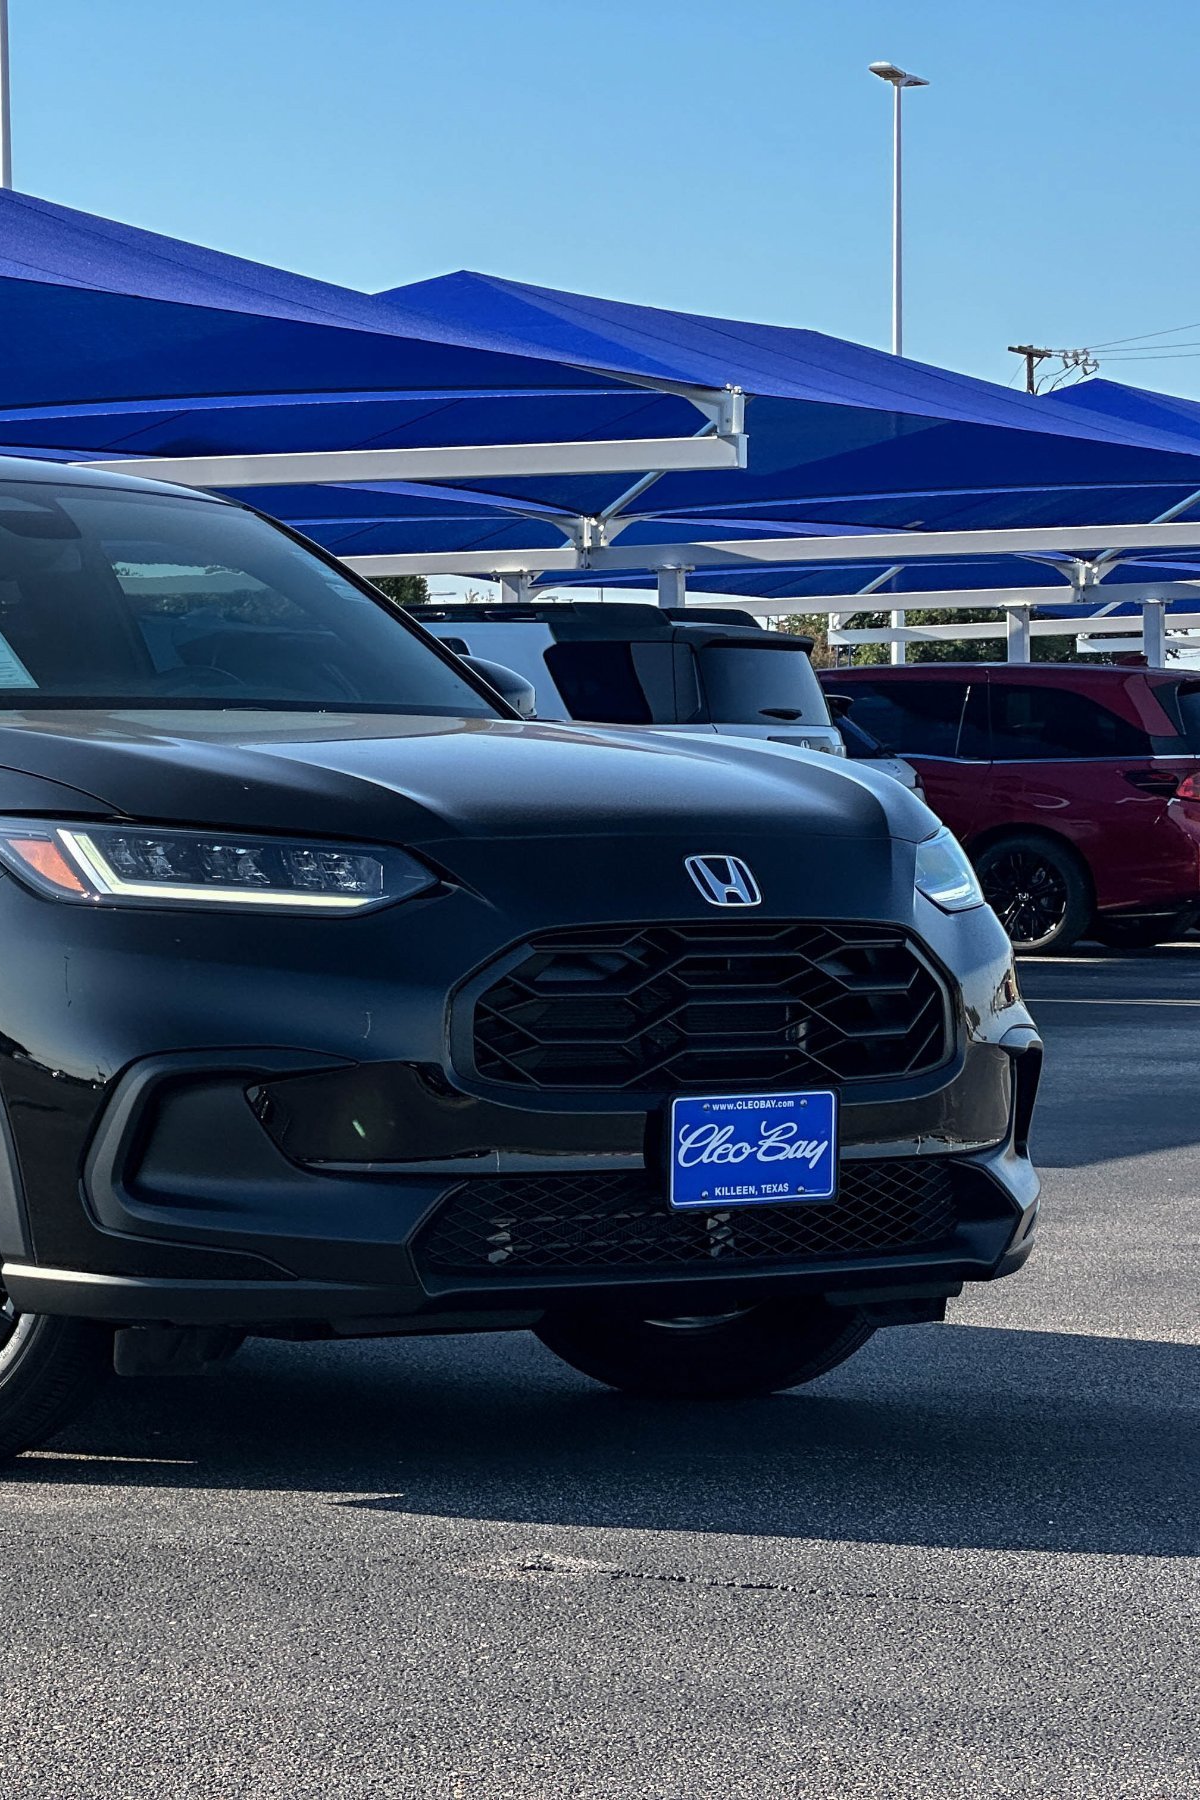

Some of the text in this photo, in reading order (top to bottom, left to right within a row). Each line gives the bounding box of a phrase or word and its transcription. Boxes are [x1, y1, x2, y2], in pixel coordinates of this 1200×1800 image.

[712, 1100, 794, 1111] www.CLEOBAY.com
[678, 1121, 829, 1169] Cleo Bay
[714, 1183, 789, 1197] KILLEEN, TEXAS
